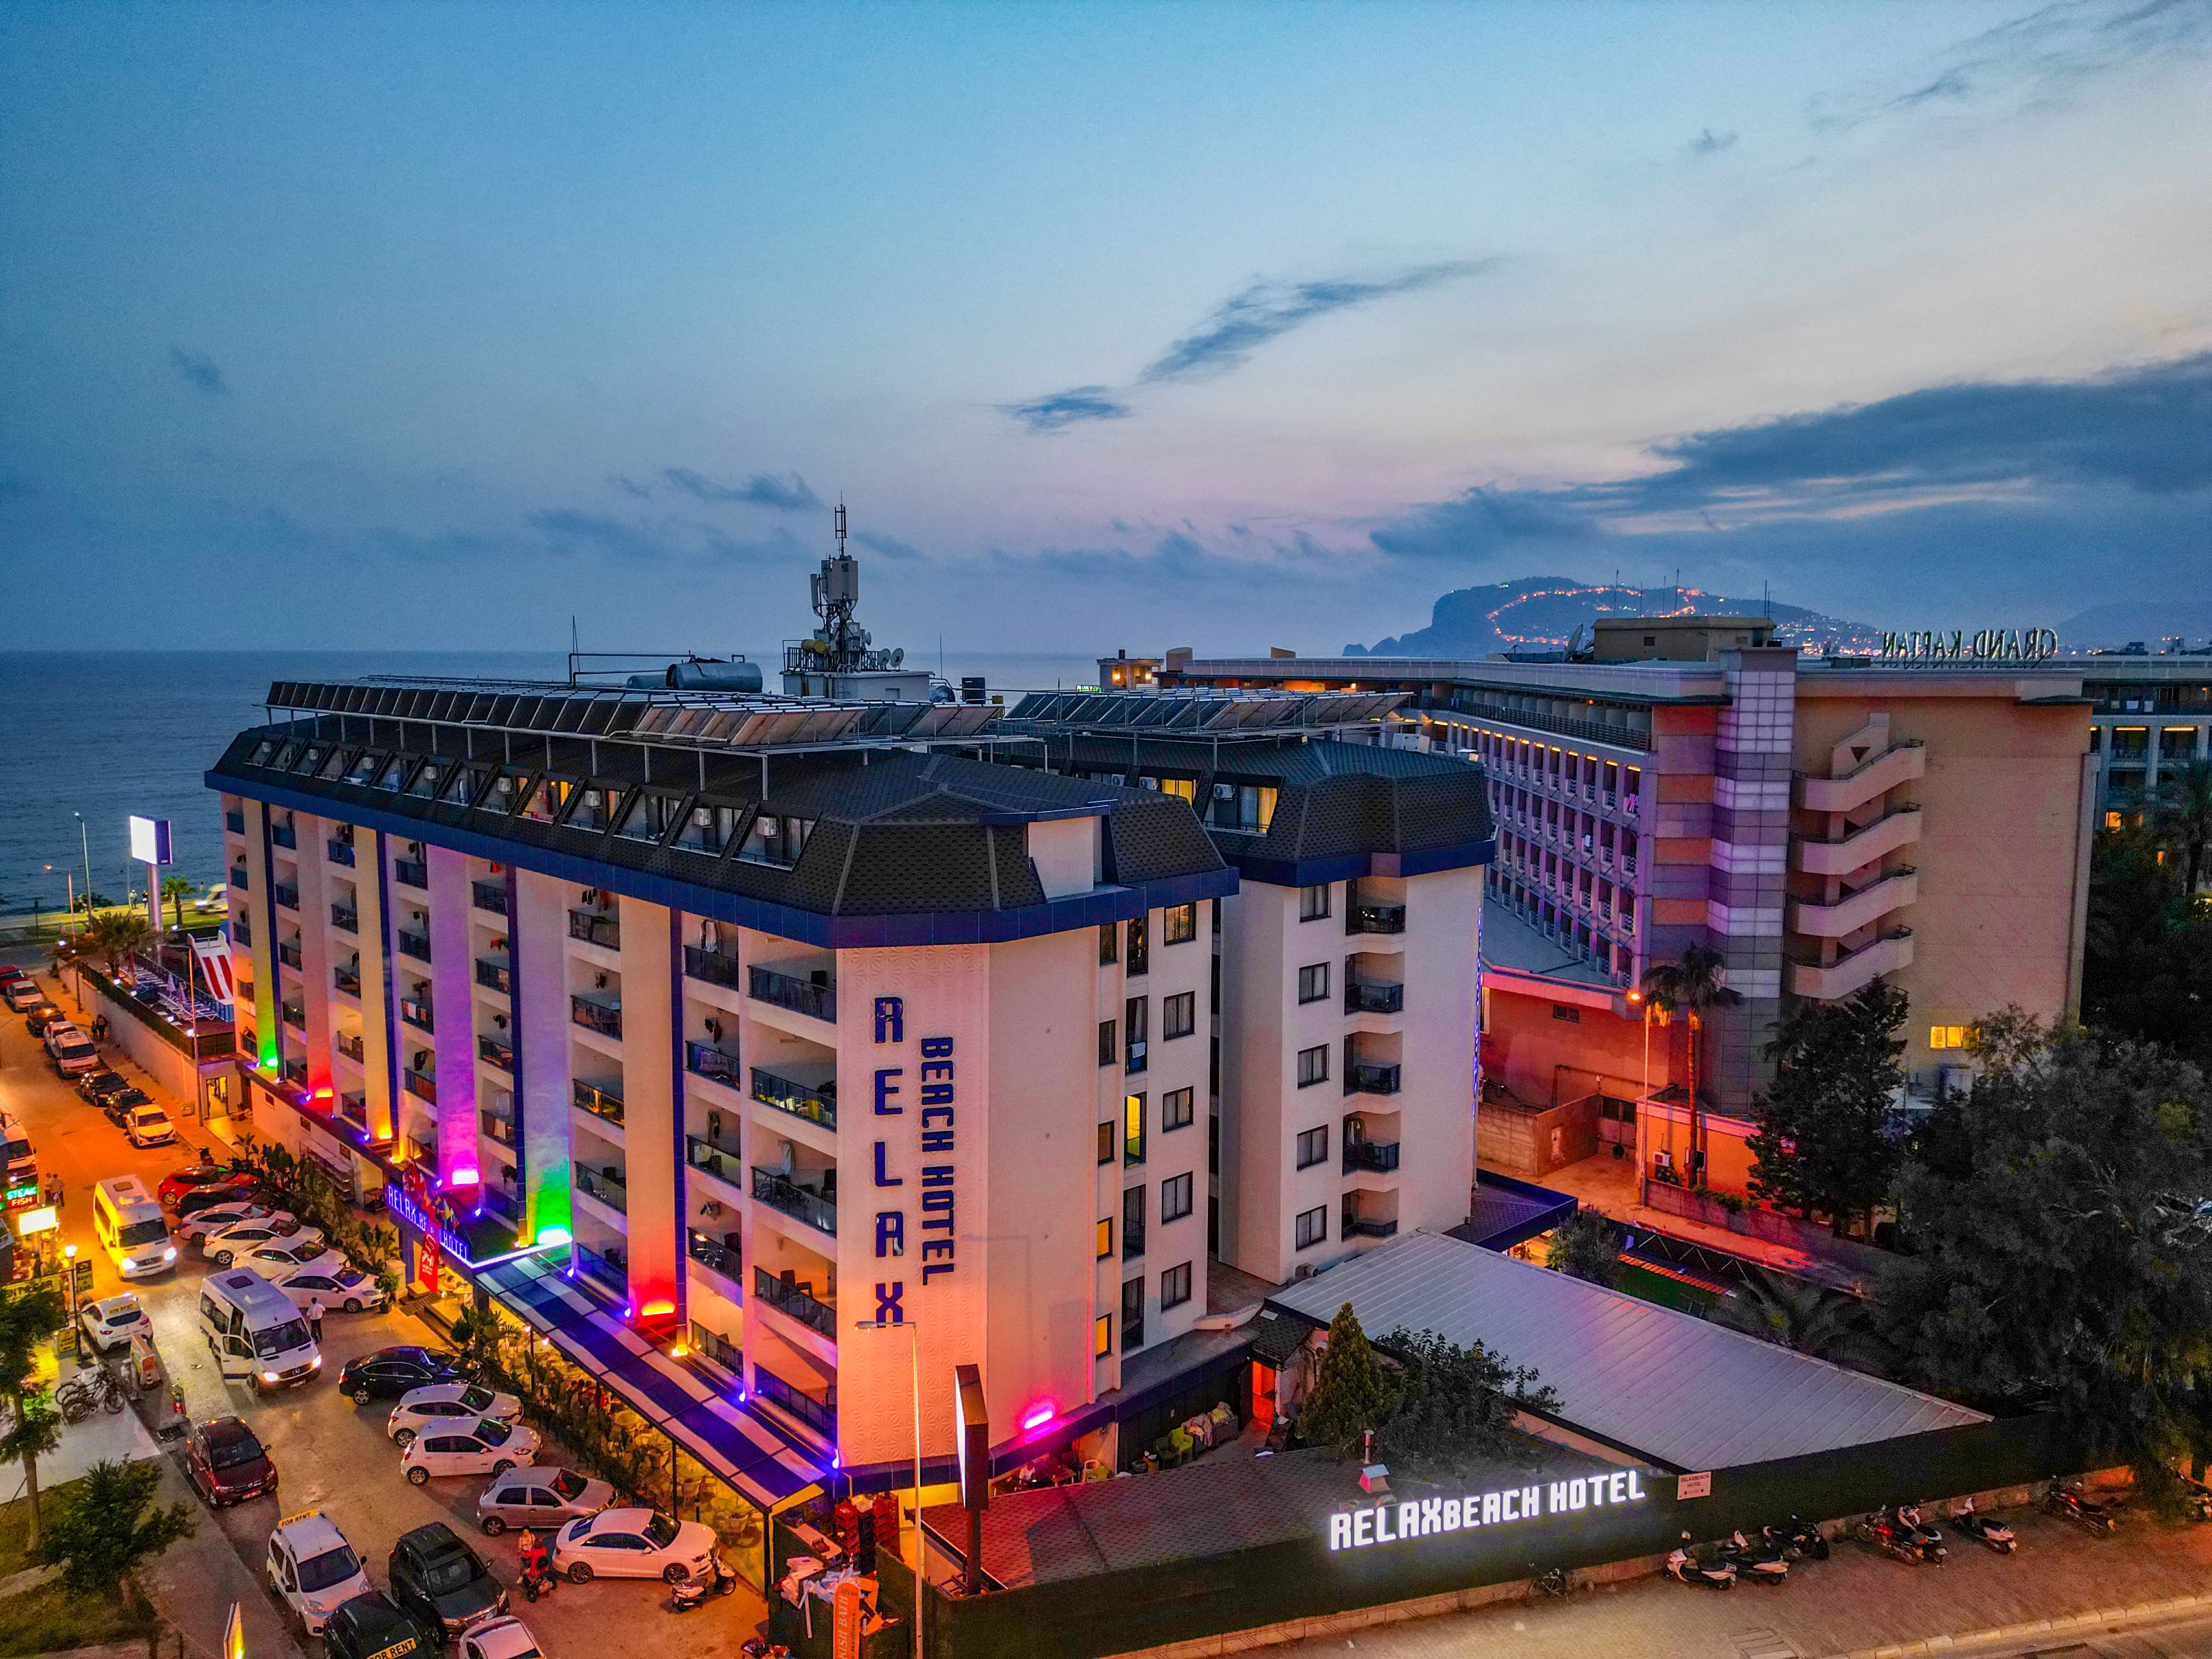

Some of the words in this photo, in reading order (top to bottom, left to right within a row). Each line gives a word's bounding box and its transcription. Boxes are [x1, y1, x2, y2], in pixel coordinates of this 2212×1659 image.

[921, 1036, 954, 1152] BEACH
[874, 997, 904, 1328] RELAX
[6, 1187, 37, 1200] STEAK
[12, 1196, 32, 1206] FISH
[388, 1185, 417, 1224] RELAX
[922, 1165, 955, 1286] HOTEL
[1550, 1470, 1646, 1513] HOTEL
[295, 1512, 310, 1521] RENT
[839, 1594, 848, 1628] BATH
[389, 1640, 414, 1657] RENT
